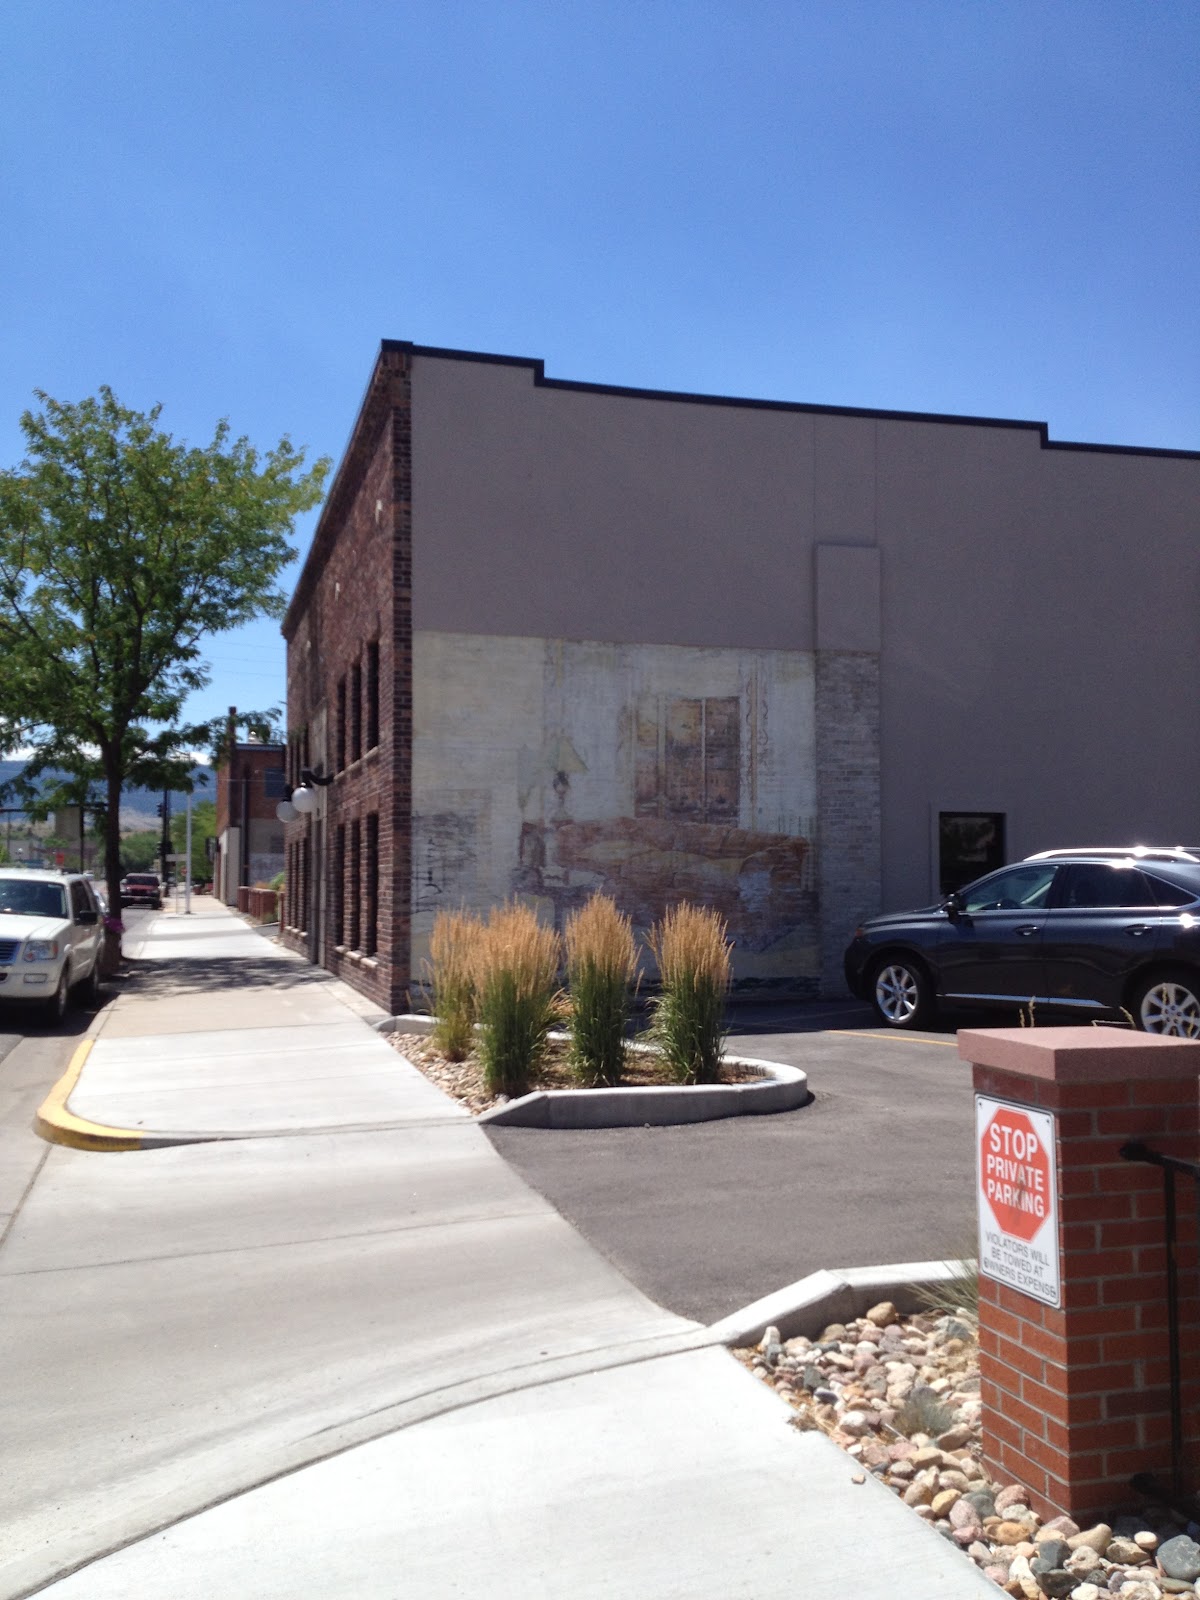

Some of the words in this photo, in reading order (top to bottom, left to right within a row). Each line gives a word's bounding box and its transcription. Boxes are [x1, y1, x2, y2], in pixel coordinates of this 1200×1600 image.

[990, 1122, 1038, 1162] STOP
[987, 1154, 1044, 1192] PRIVATE
[987, 1178, 1045, 1218] PARKING
[985, 1231, 1029, 1258] VIOLATORS
[1030, 1248, 1050, 1267] WILL
[991, 1246, 1002, 1260] BE
[1003, 1252, 1033, 1272] TOWED
[1034, 1264, 1044, 1277] AT
[983, 1257, 1016, 1281] OWNERS
[1017, 1272, 1056, 1297] EXPENSE
